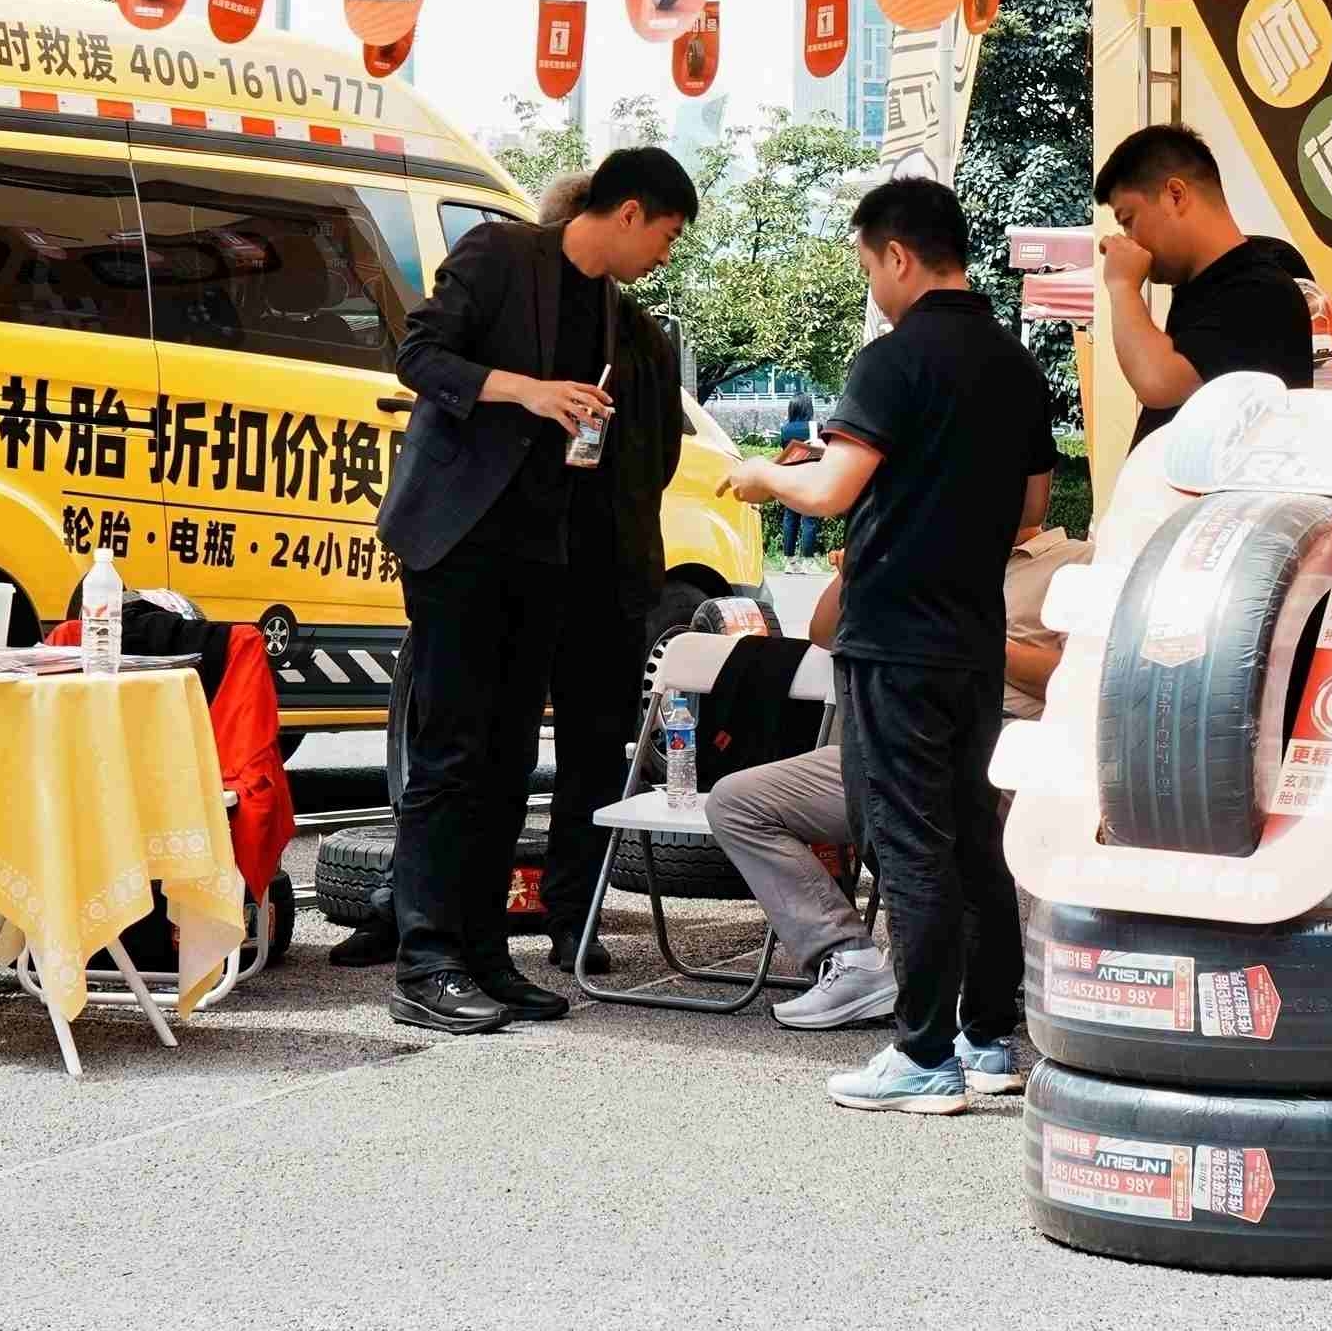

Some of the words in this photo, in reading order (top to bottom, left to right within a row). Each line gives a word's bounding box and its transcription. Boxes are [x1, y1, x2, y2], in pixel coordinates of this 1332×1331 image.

[130, 45, 386, 121] 400-1610-777
[1098, 967, 1168, 986] ARISUN1
[1128, 990, 1157, 1007] 98Y
[1095, 1153, 1168, 1174] ARISUN1
[1125, 1175, 1156, 1193] 98Y
